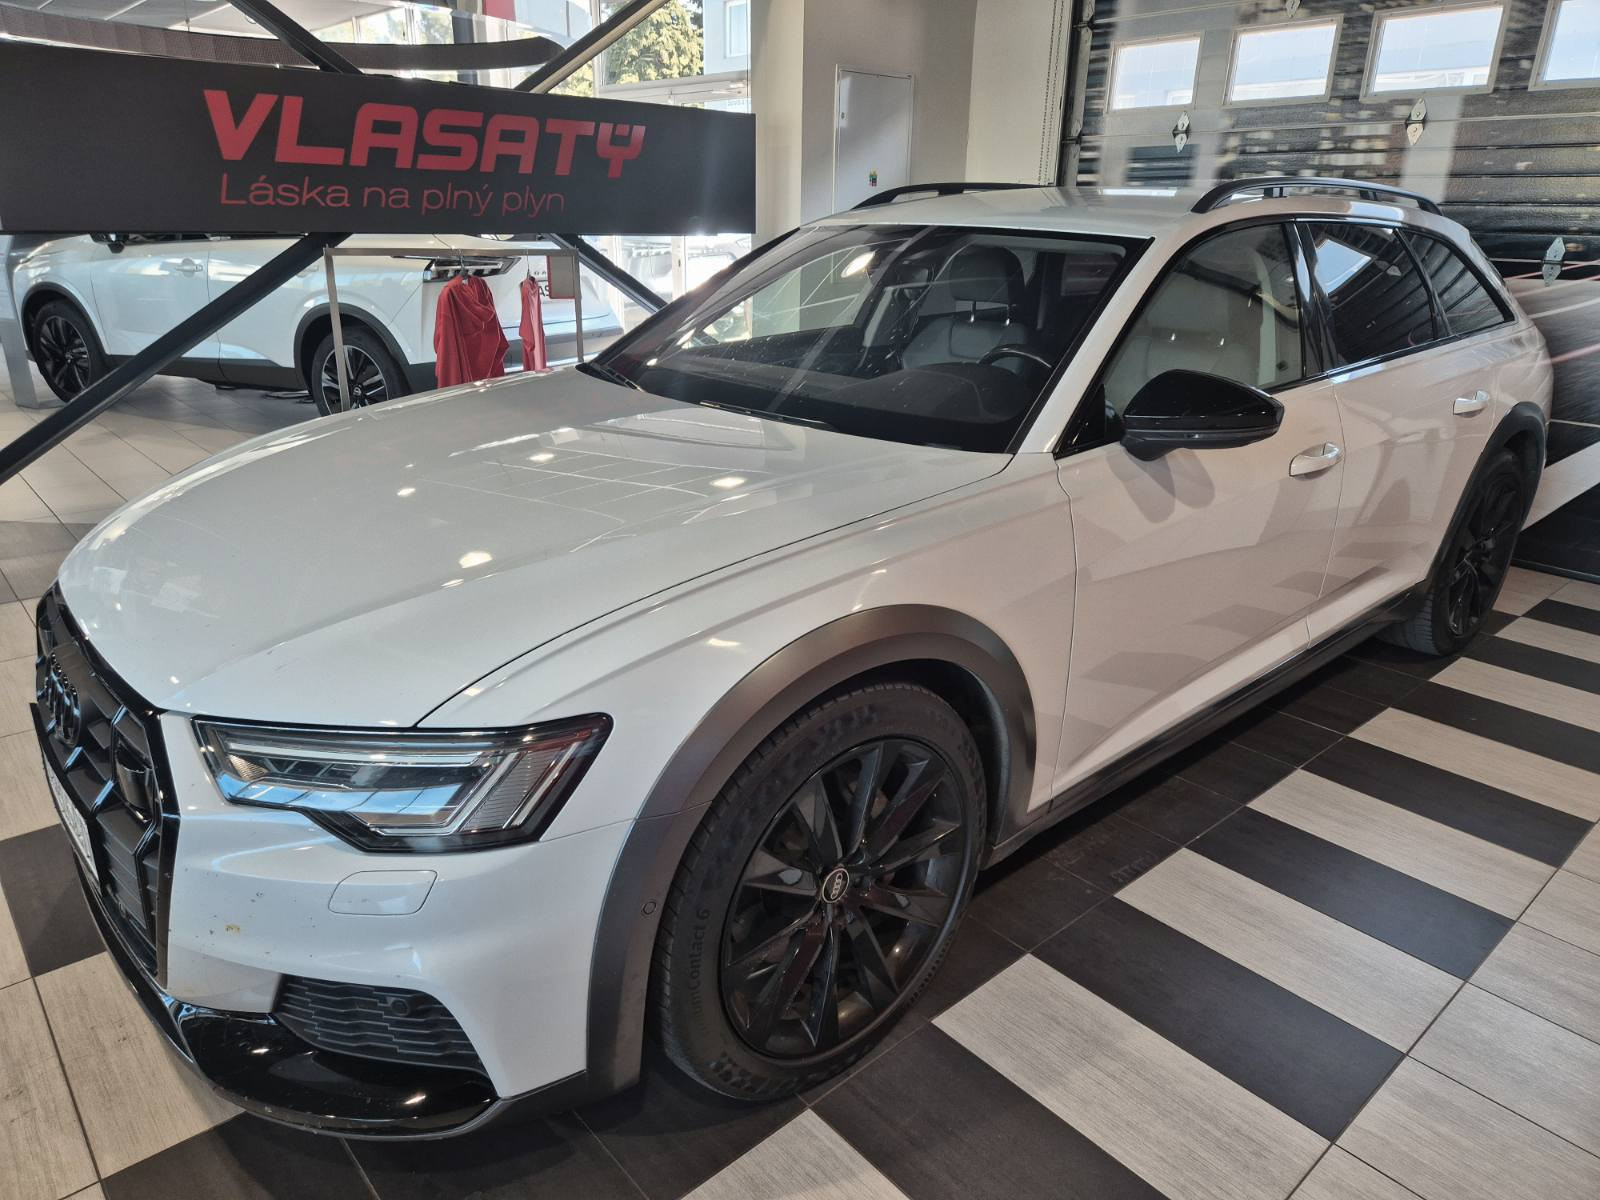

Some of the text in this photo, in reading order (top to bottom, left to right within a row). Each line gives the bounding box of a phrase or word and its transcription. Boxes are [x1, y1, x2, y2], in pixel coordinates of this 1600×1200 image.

[220, 173, 566, 217] Láska na plný plyn
